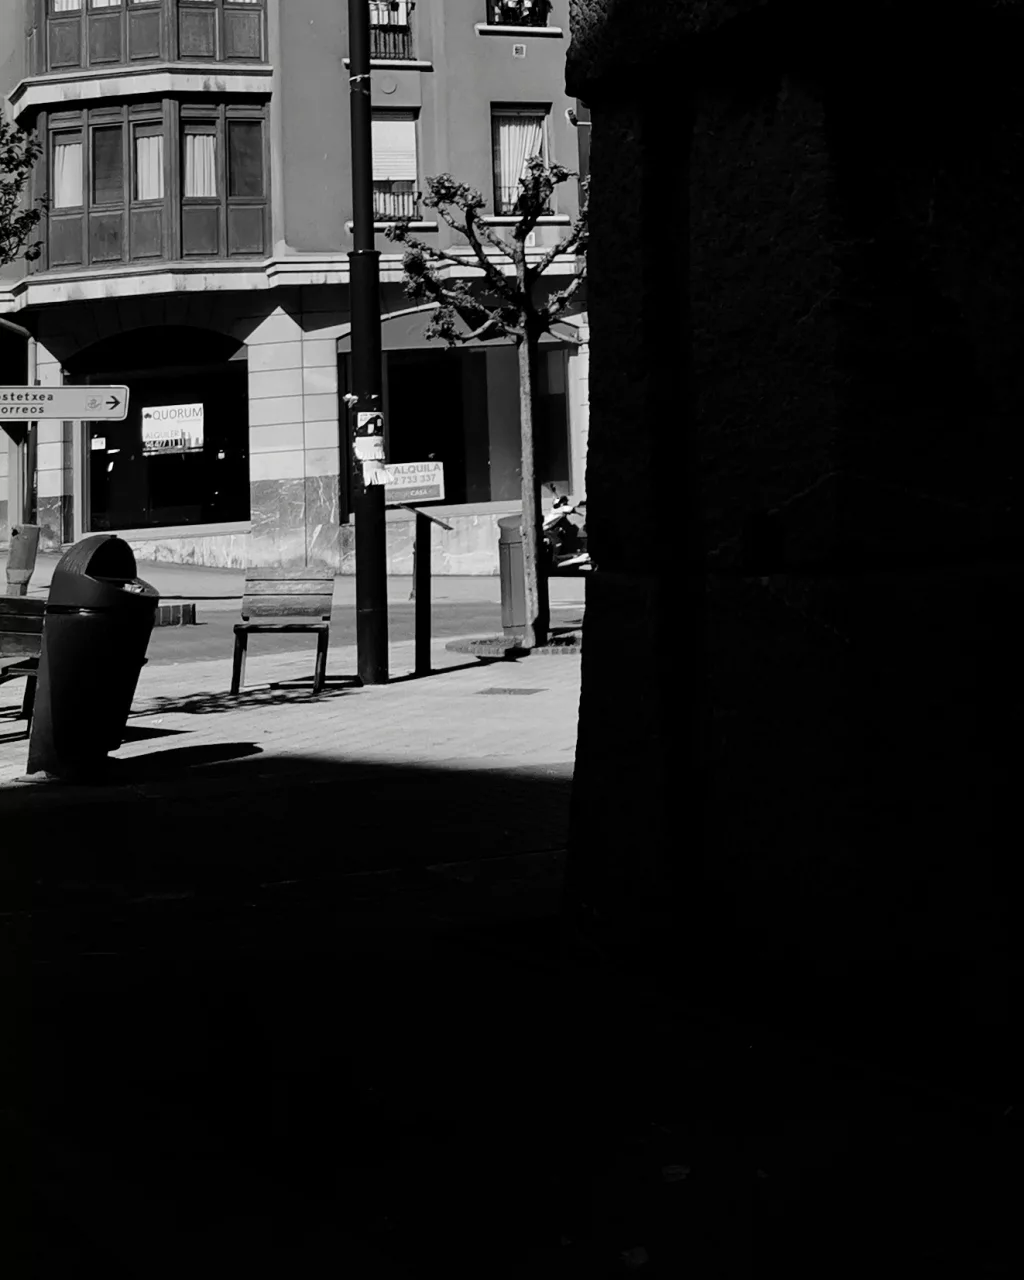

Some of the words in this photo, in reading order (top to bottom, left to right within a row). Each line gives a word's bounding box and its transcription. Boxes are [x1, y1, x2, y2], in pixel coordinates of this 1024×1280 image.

[0, 392, 54, 401] stetxea
[153, 407, 203, 421] QUORUM
[393, 463, 441, 475] ALQUILA
